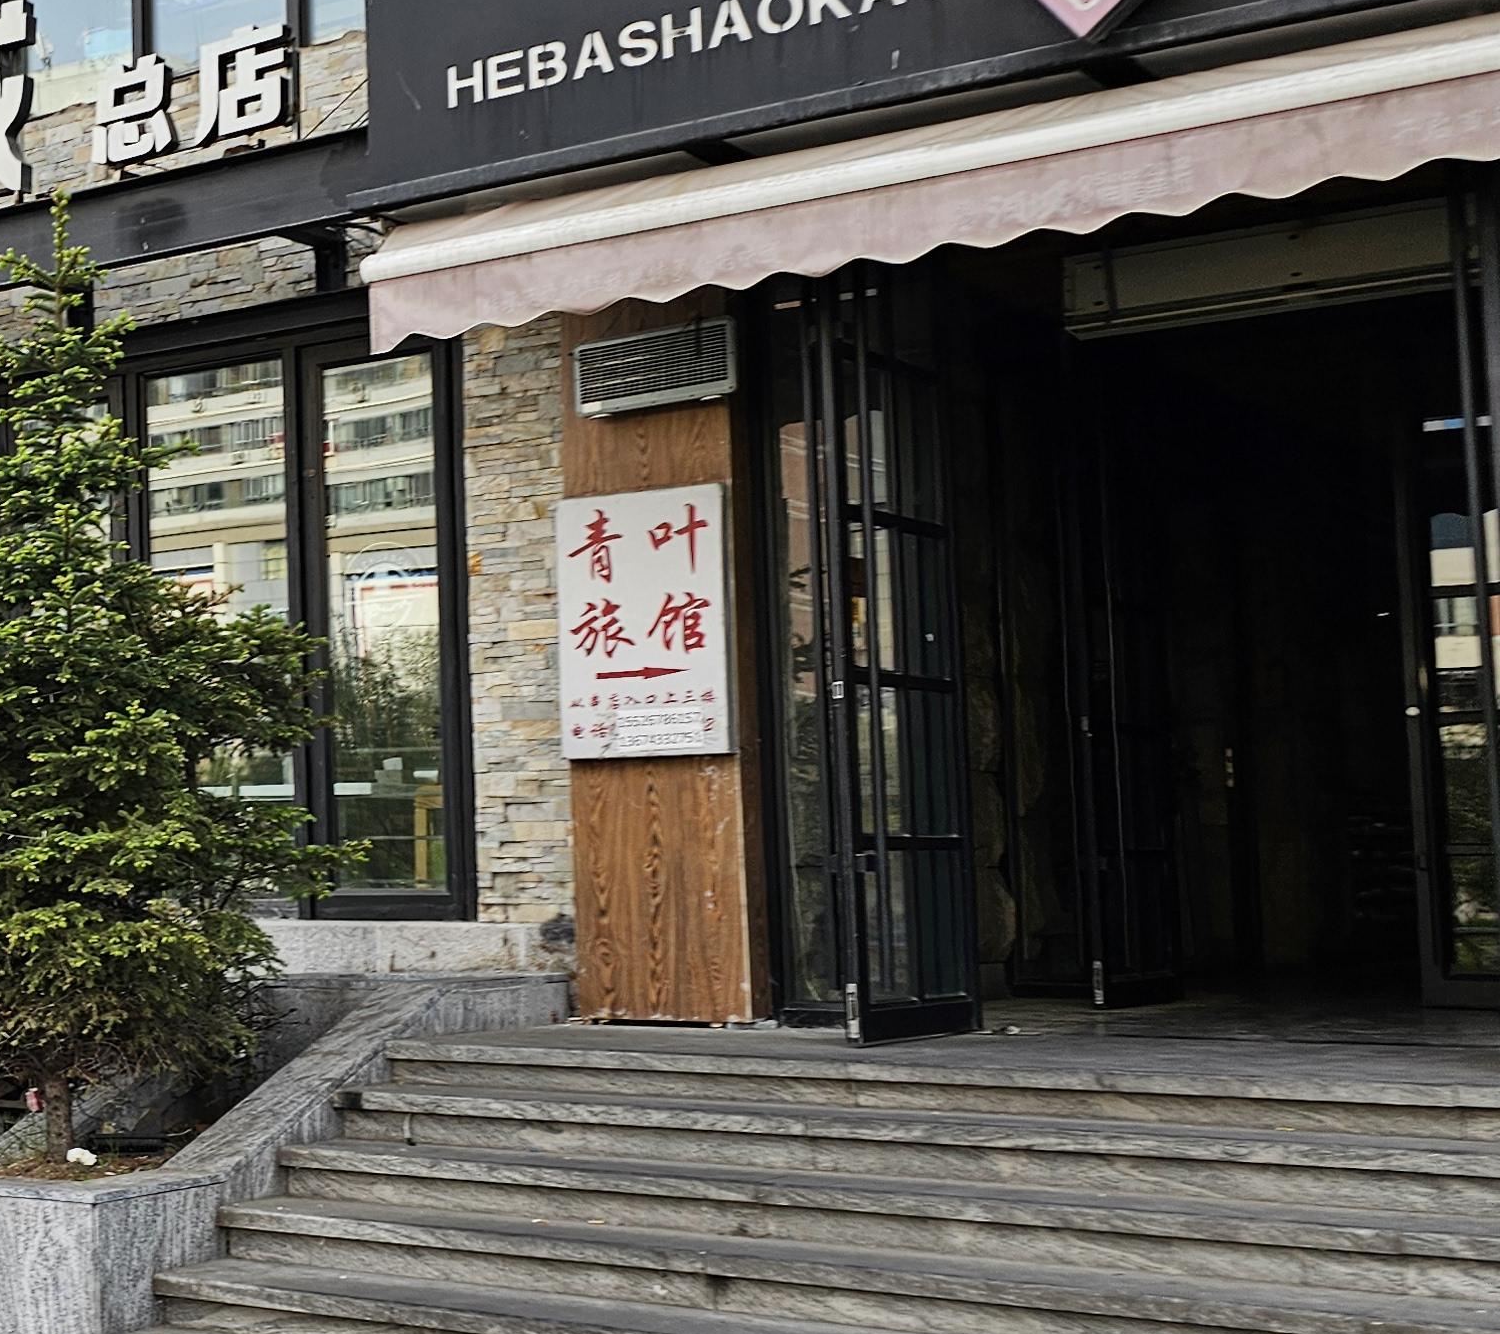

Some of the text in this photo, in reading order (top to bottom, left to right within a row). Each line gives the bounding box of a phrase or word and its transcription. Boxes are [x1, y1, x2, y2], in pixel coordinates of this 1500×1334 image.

[91, 23, 288, 165] 总店
[566, 503, 709, 584] 青叶
[569, 591, 712, 658] 旅馆
